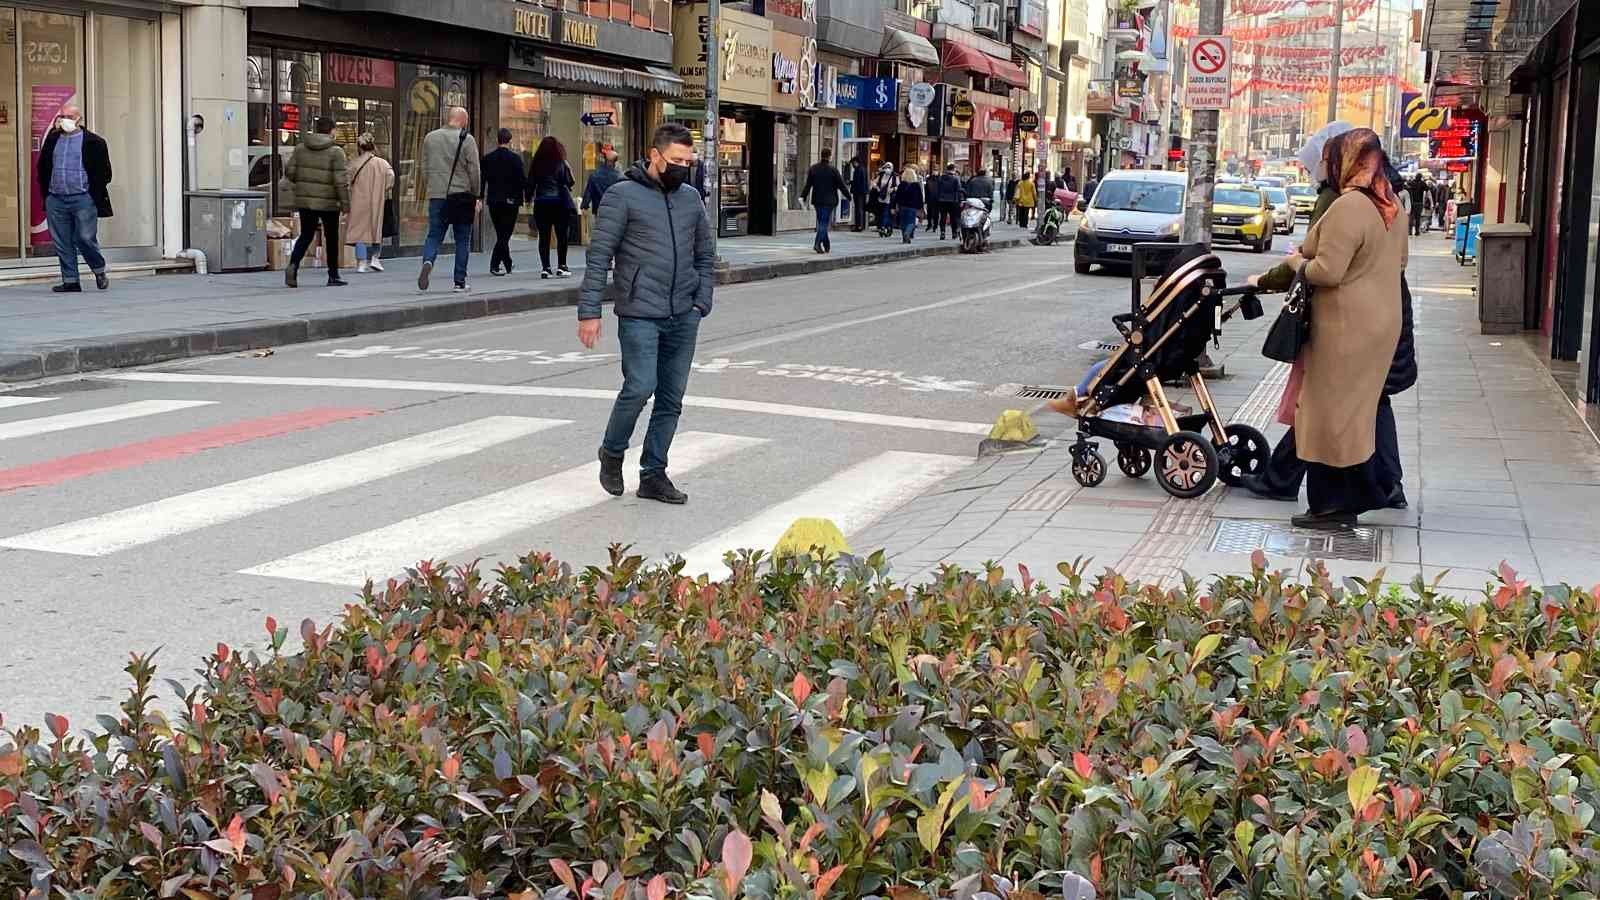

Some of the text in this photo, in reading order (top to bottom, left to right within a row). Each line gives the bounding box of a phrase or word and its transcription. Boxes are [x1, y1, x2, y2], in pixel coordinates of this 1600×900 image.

[514, 8, 598, 48] HOTEL KONAK
[695, 66, 706, 77] SAT
[836, 83, 857, 100] ANKASI
